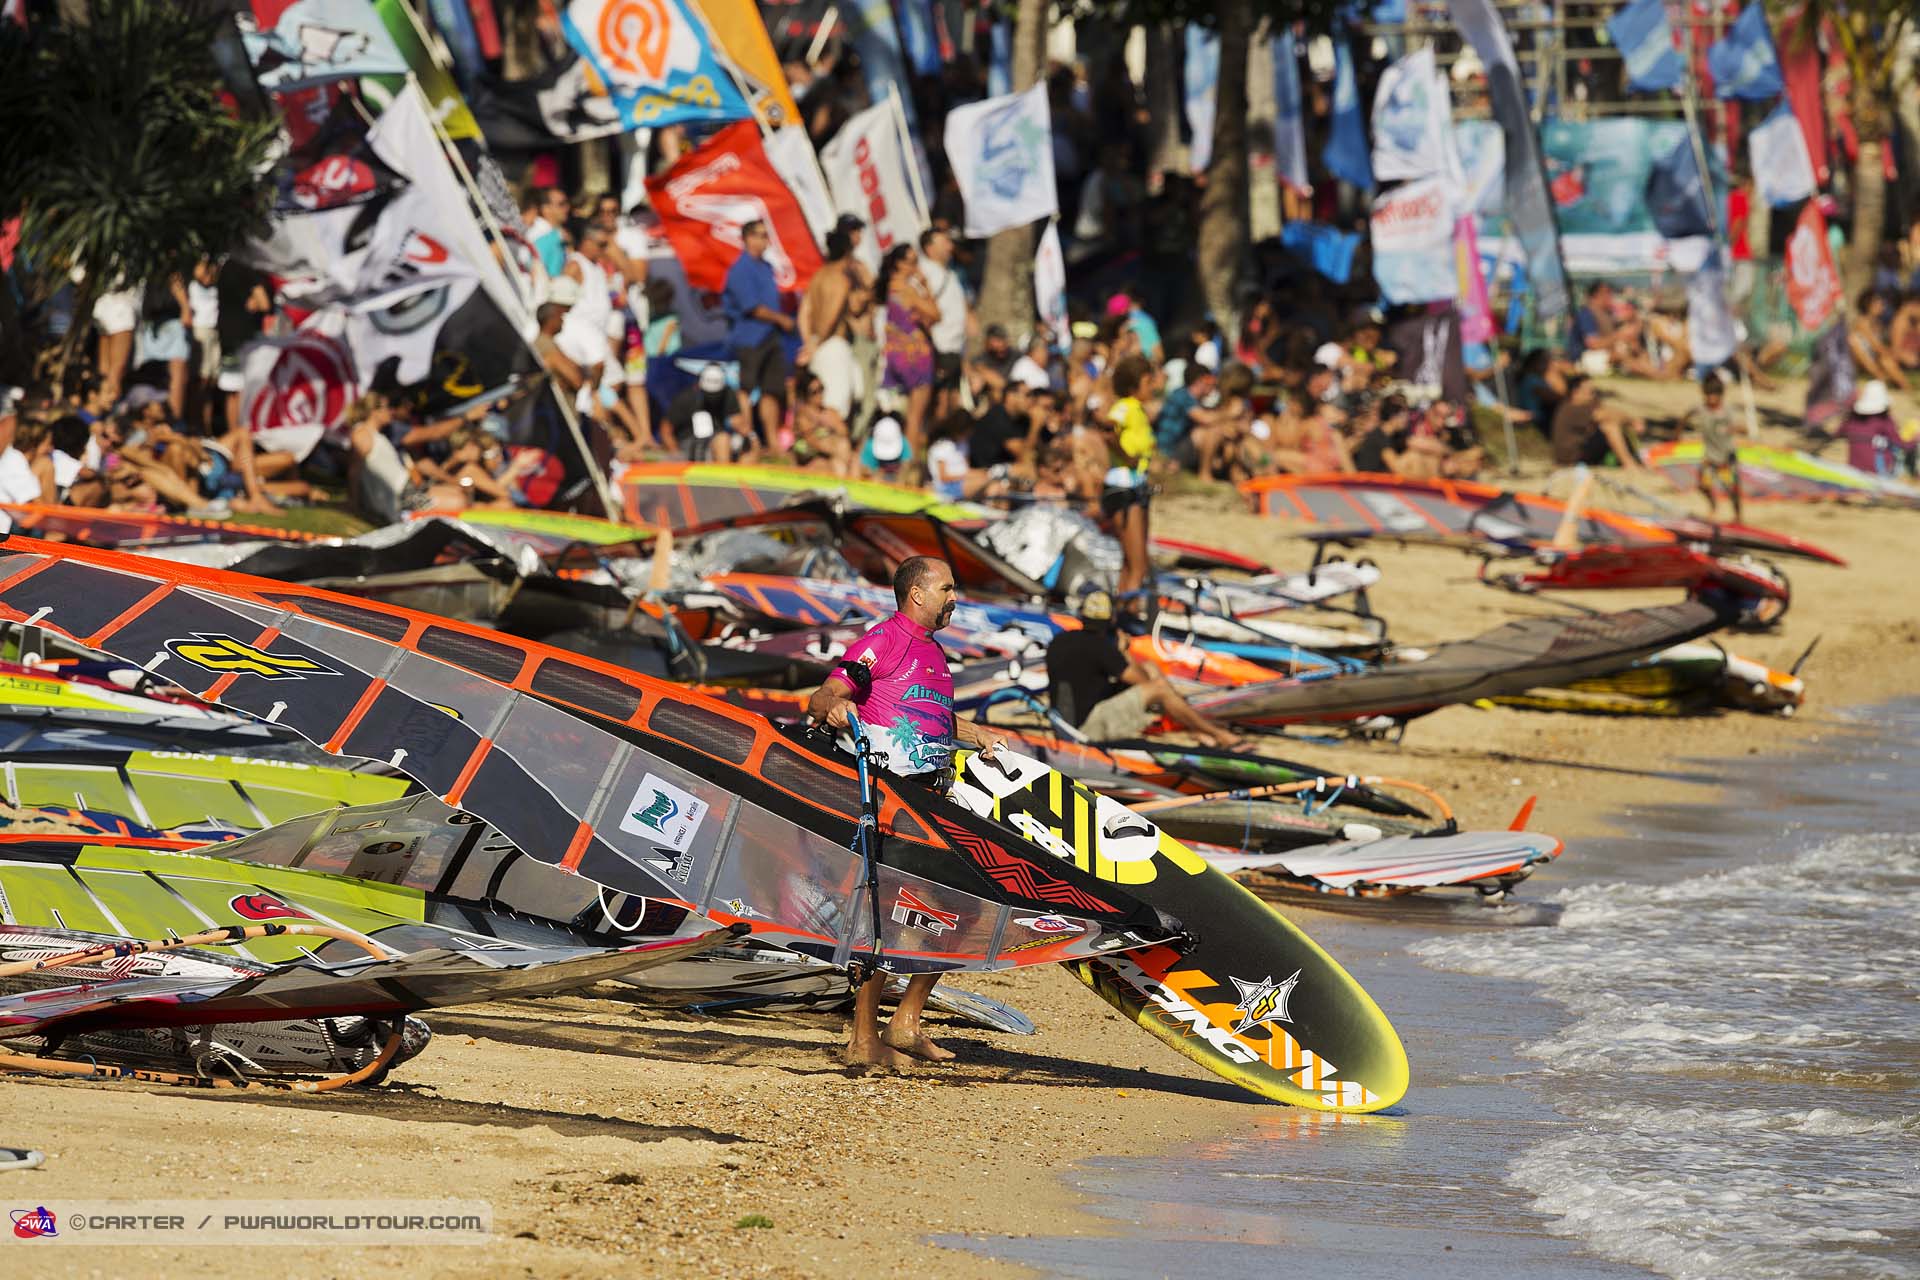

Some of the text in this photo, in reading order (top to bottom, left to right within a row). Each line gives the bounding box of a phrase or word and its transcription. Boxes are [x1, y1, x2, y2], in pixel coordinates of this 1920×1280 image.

[151, 751, 311, 770] GUN SAILS
[1097, 955, 1261, 1064] ACING
